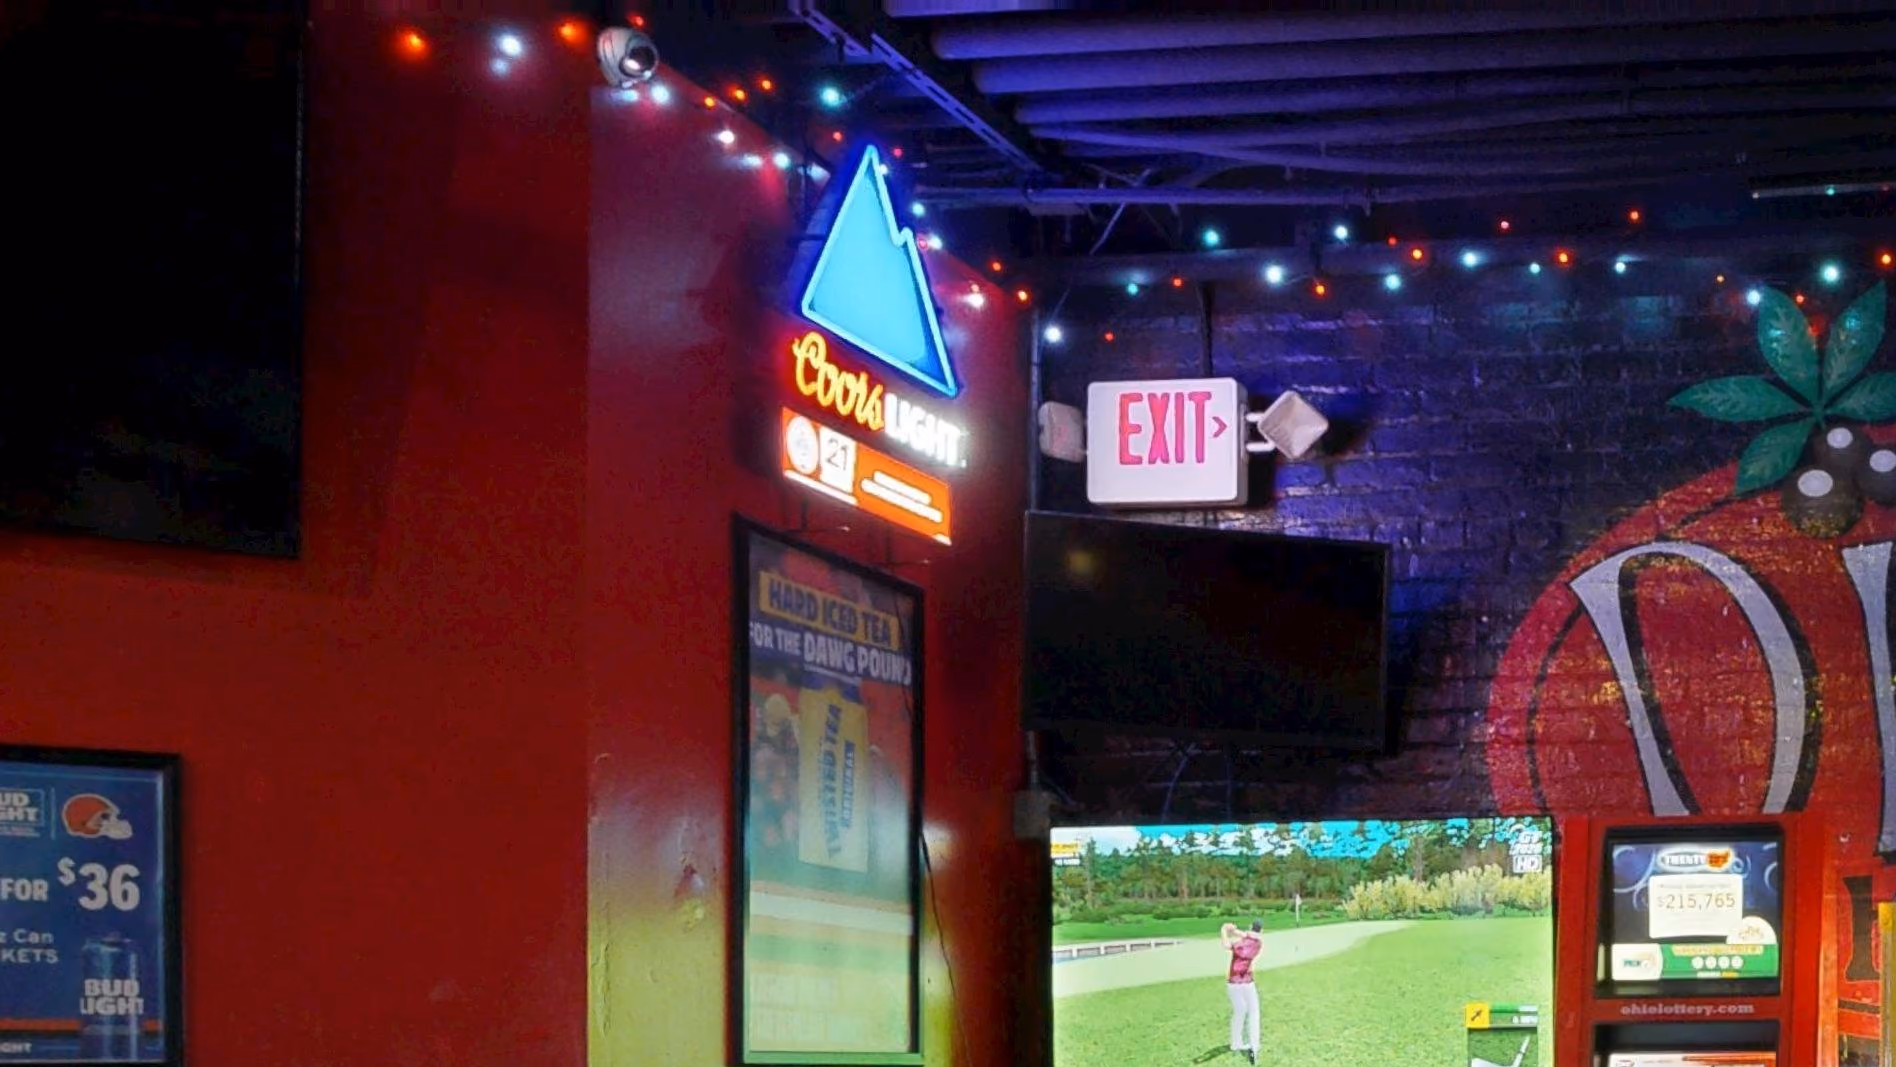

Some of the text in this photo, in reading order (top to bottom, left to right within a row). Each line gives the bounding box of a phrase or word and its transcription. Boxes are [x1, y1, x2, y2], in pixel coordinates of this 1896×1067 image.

[792, 332, 884, 430] Coors
[884, 393, 968, 468] LIGHT
[1118, 391, 1213, 466] EXIT
[825, 437, 849, 471] 21
[768, 578, 892, 647] HARD ICED TEA
[775, 626, 801, 656] THE
[803, 631, 856, 673] DAWG
[856, 645, 912, 686] POUND
[0, 792, 30, 807] UD
[0, 806, 39, 822] GHT
[1, 856, 141, 912] FOR $36
[1656, 892, 1737, 911] $215,765
[13, 927, 55, 944] Can
[1, 947, 59, 964] KETS
[83, 978, 140, 997] BUD
[1619, 1003, 1755, 1016] ohiolottery.com
